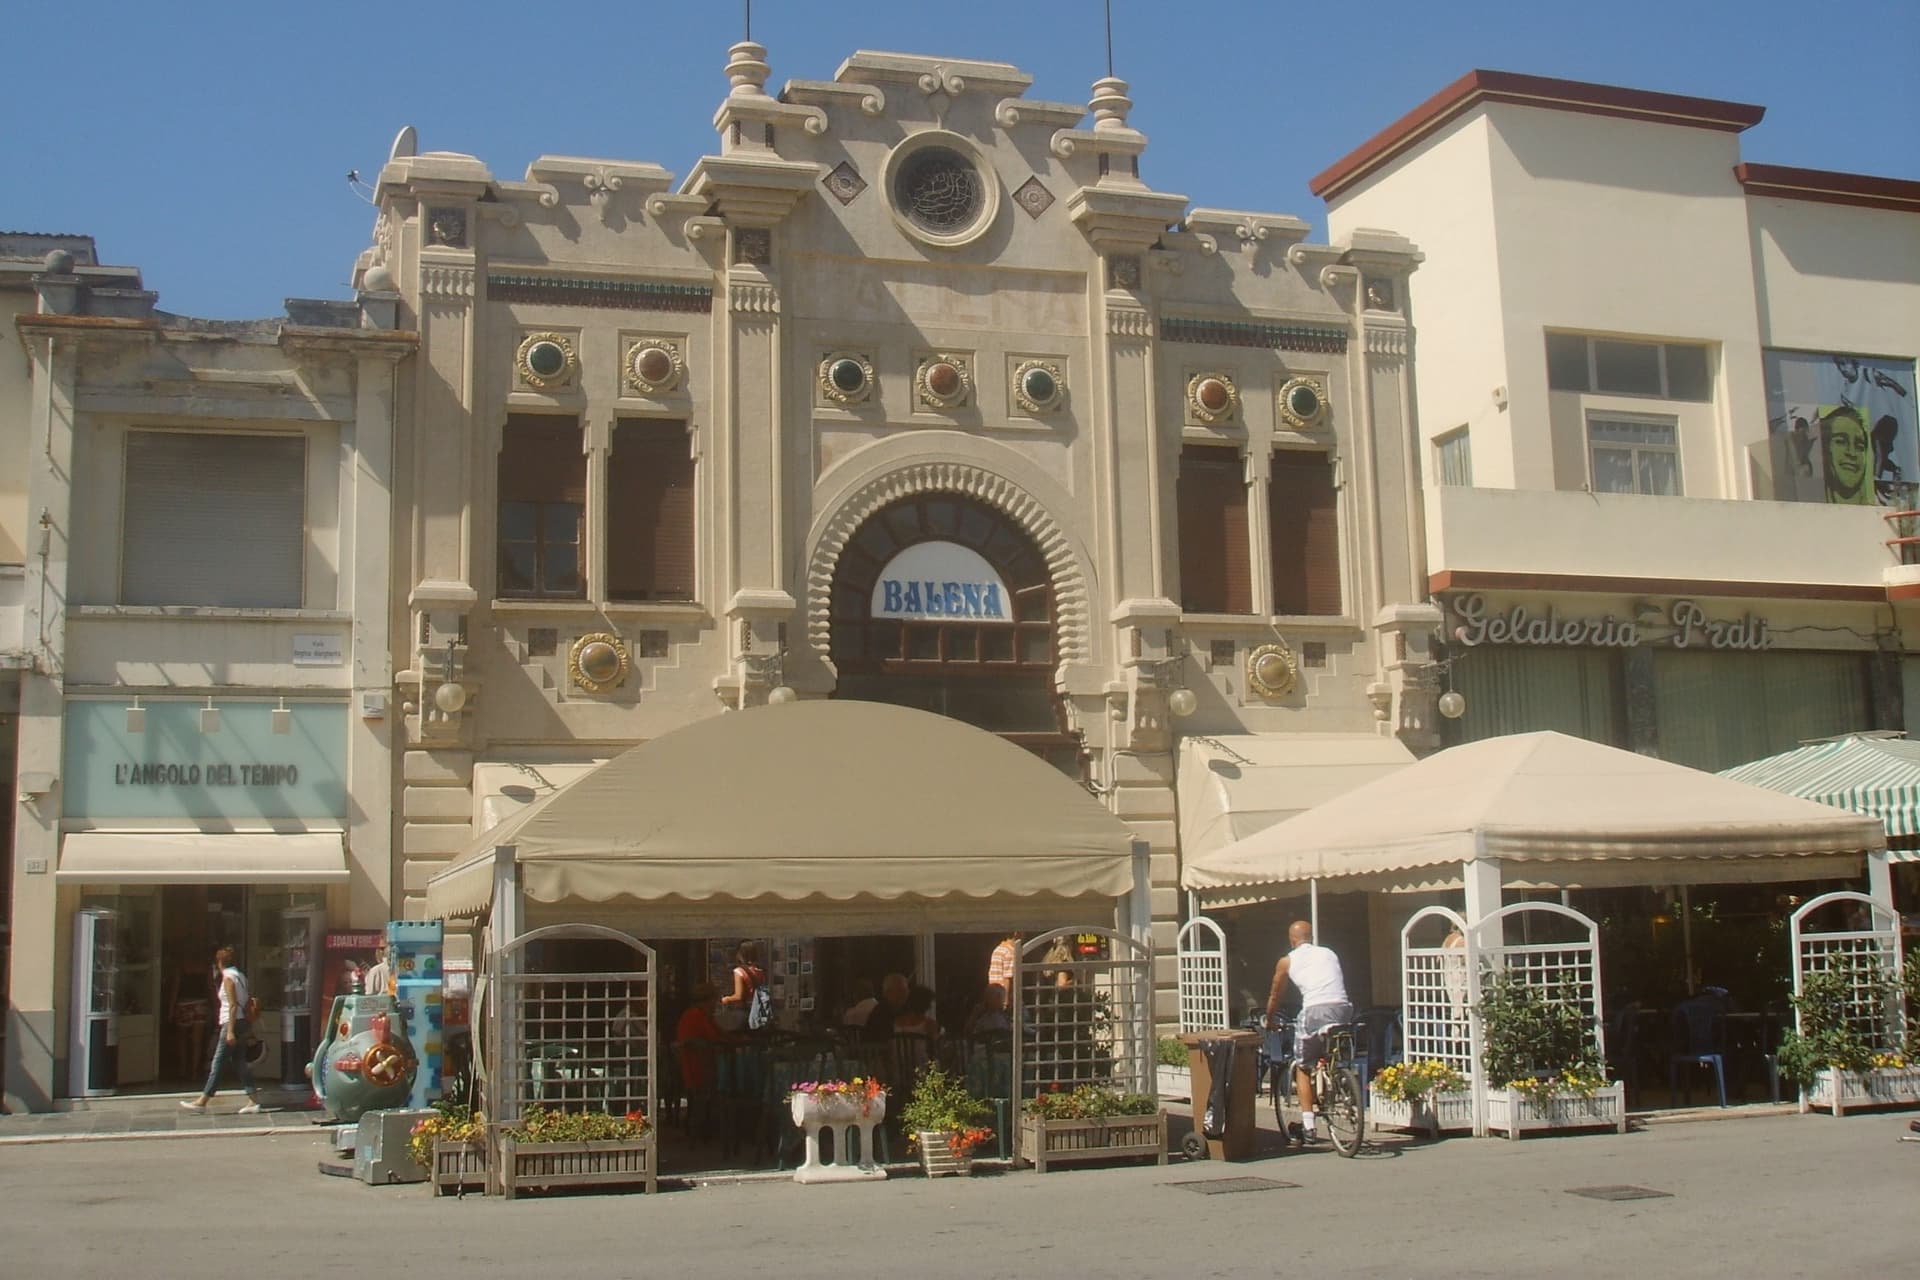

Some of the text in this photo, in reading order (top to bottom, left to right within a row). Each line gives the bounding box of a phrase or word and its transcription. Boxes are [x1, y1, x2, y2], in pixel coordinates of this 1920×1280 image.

[883, 580, 1004, 618] BALENA
[1453, 592, 1773, 650] Gelateria Prati
[115, 764, 298, 787] L'ANGOLO DEL TEMPO
